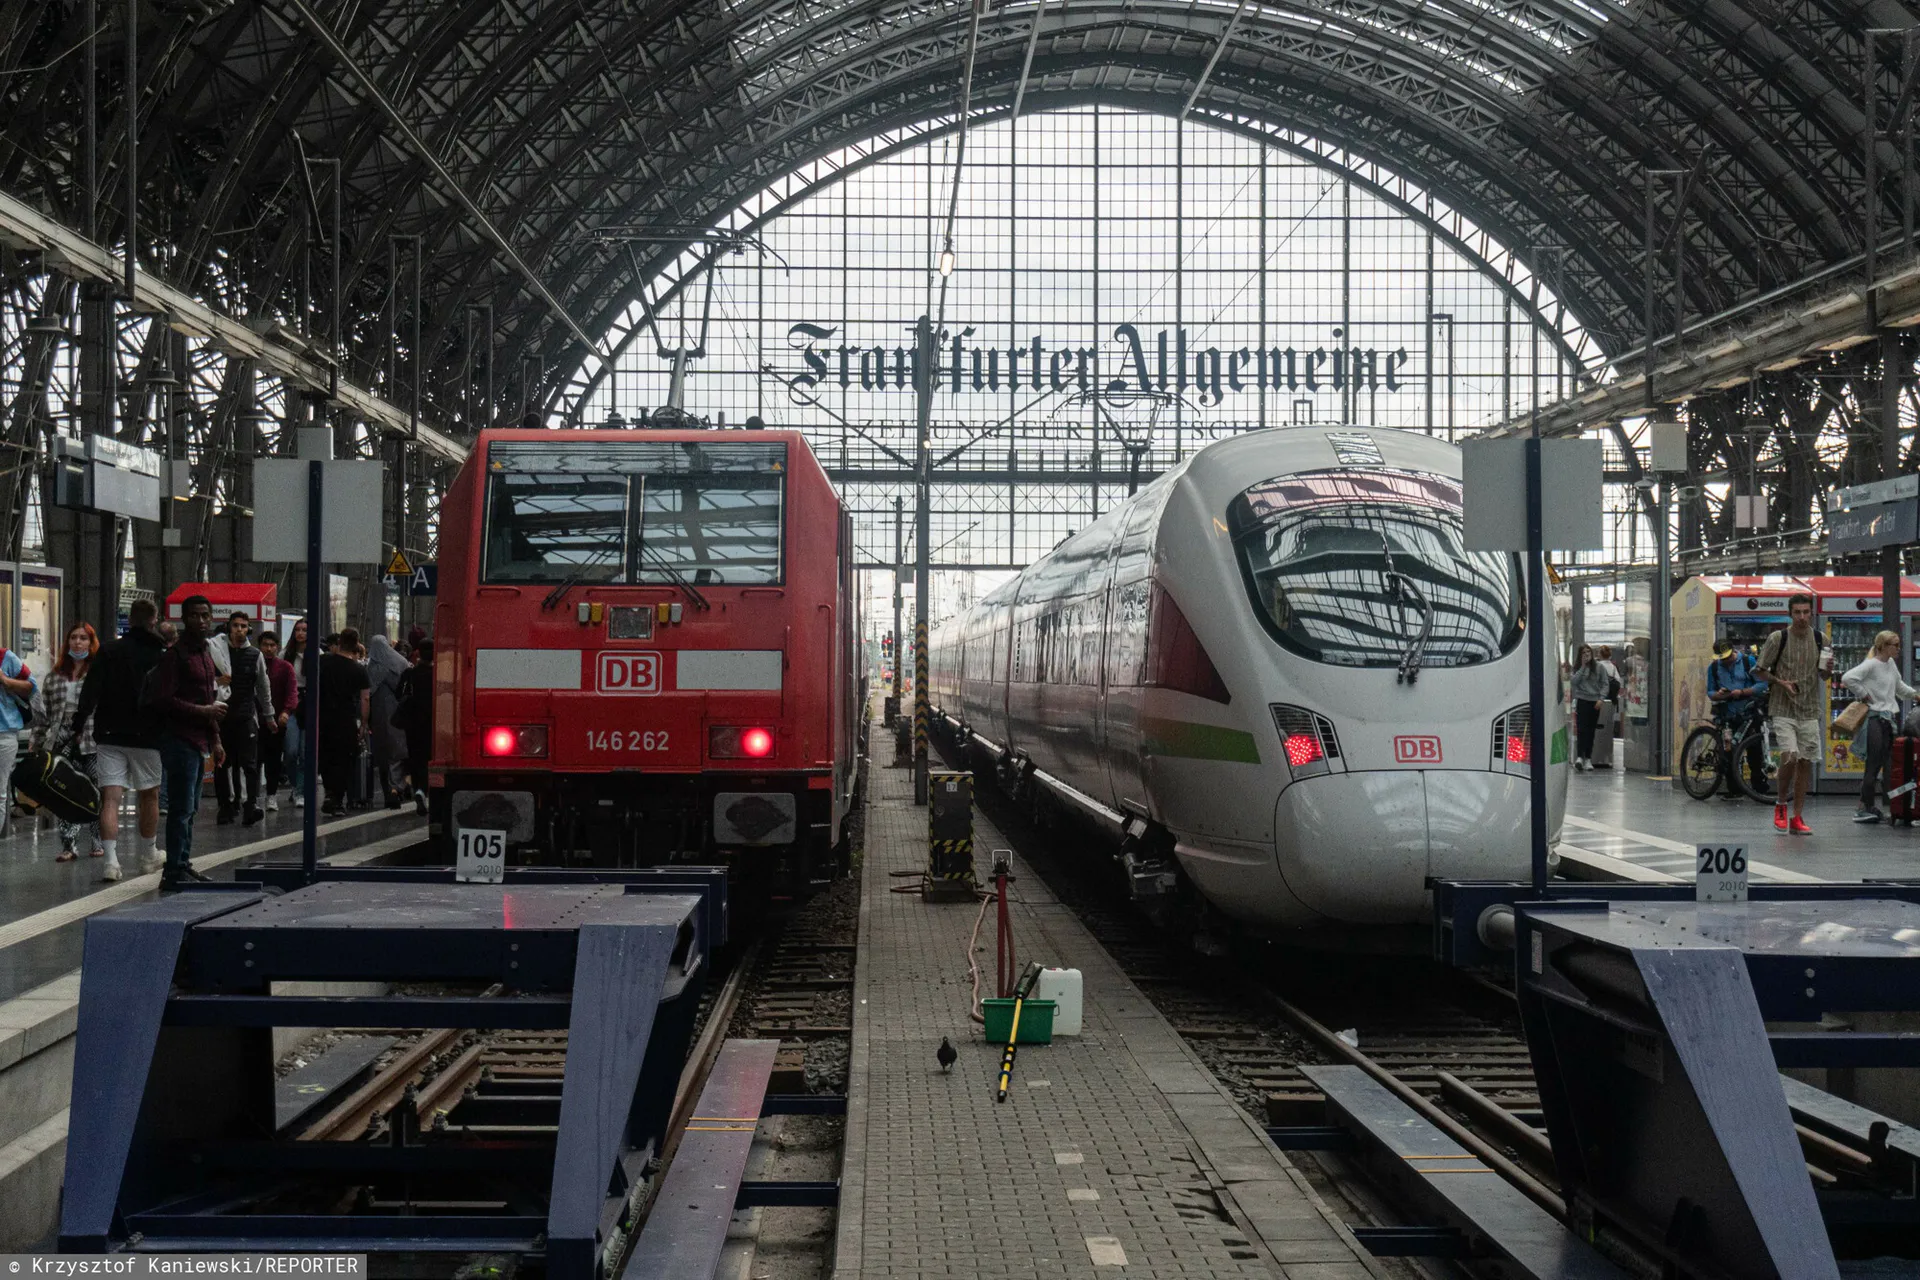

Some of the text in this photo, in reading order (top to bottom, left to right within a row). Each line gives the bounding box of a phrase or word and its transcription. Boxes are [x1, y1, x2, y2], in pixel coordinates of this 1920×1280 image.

[1105, 323, 1407, 407] Allgemeine
[858, 419, 1001, 440] ZEIUNG
[412, 566, 429, 588] A
[1760, 600, 1784, 608] selecta
[1868, 600, 1884, 608] sele
[603, 657, 655, 689] DB
[586, 730, 669, 751] 146 262
[1398, 738, 1438, 759] DB
[947, 783, 957, 791] 17
[461, 834, 502, 858] 105
[476, 864, 502, 874] 2010
[1699, 847, 1746, 874] 206
[1718, 881, 1745, 891] 2010
